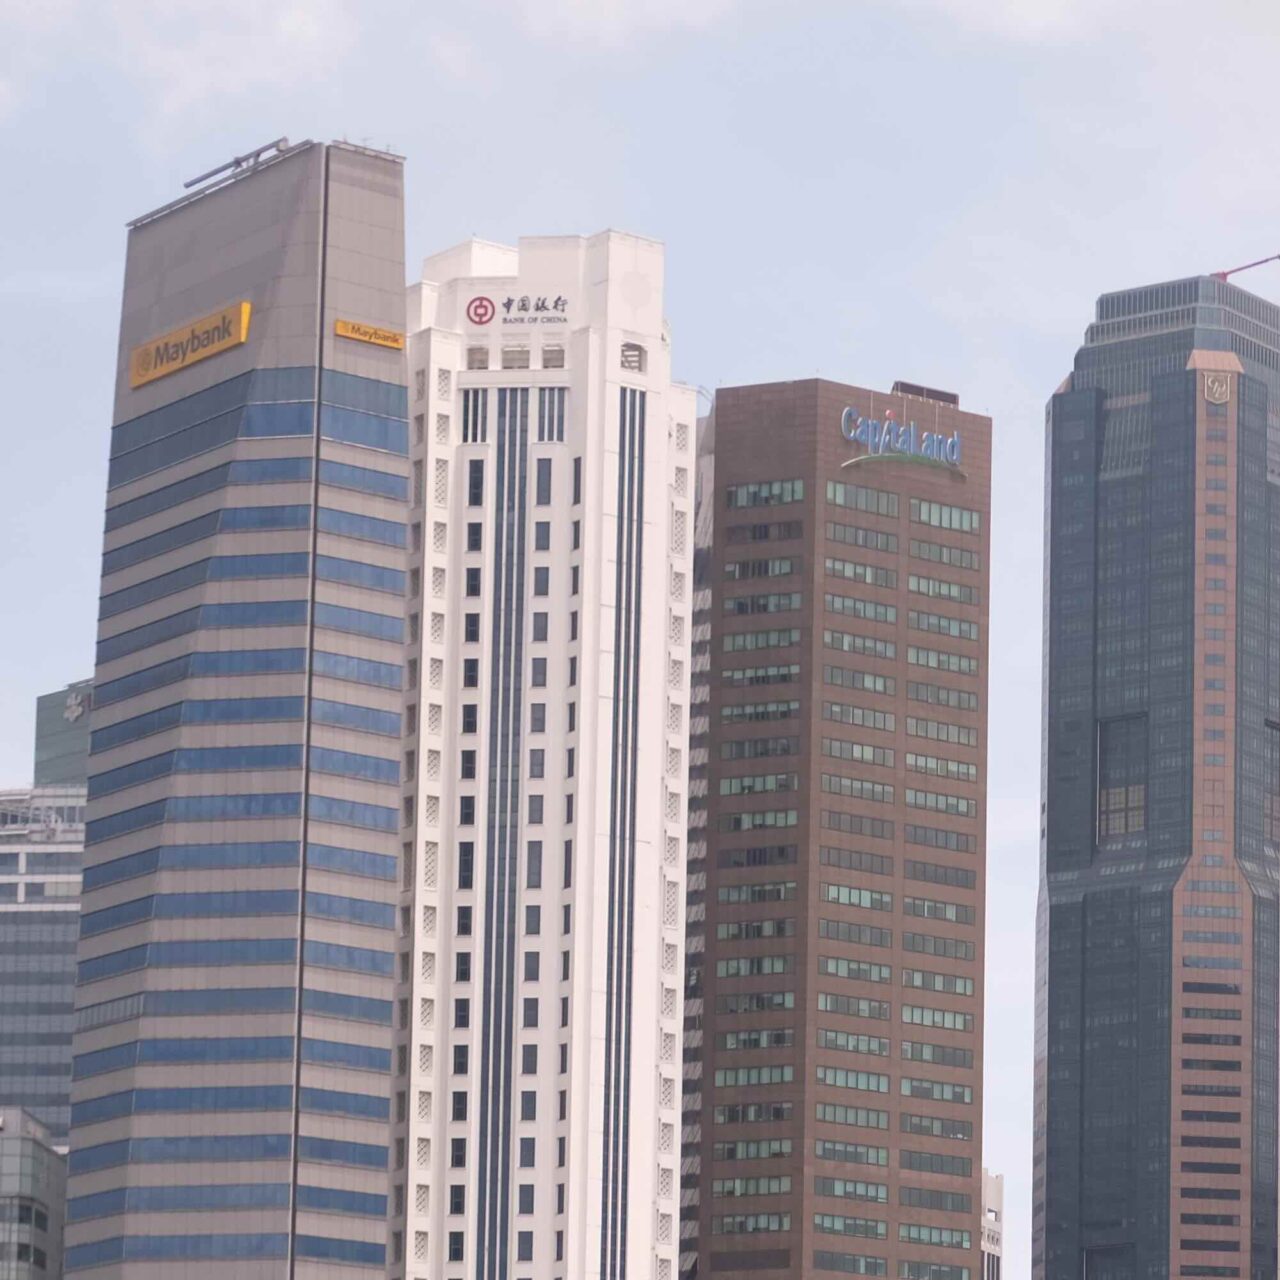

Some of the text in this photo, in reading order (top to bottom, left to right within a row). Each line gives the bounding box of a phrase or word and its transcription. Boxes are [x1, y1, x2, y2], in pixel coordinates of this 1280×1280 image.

[351, 323, 401, 345] Maybank
[502, 316, 568, 325] BANK OF CHINA
[154, 315, 233, 370] Maybank
[841, 406, 961, 466] CapitaLand
